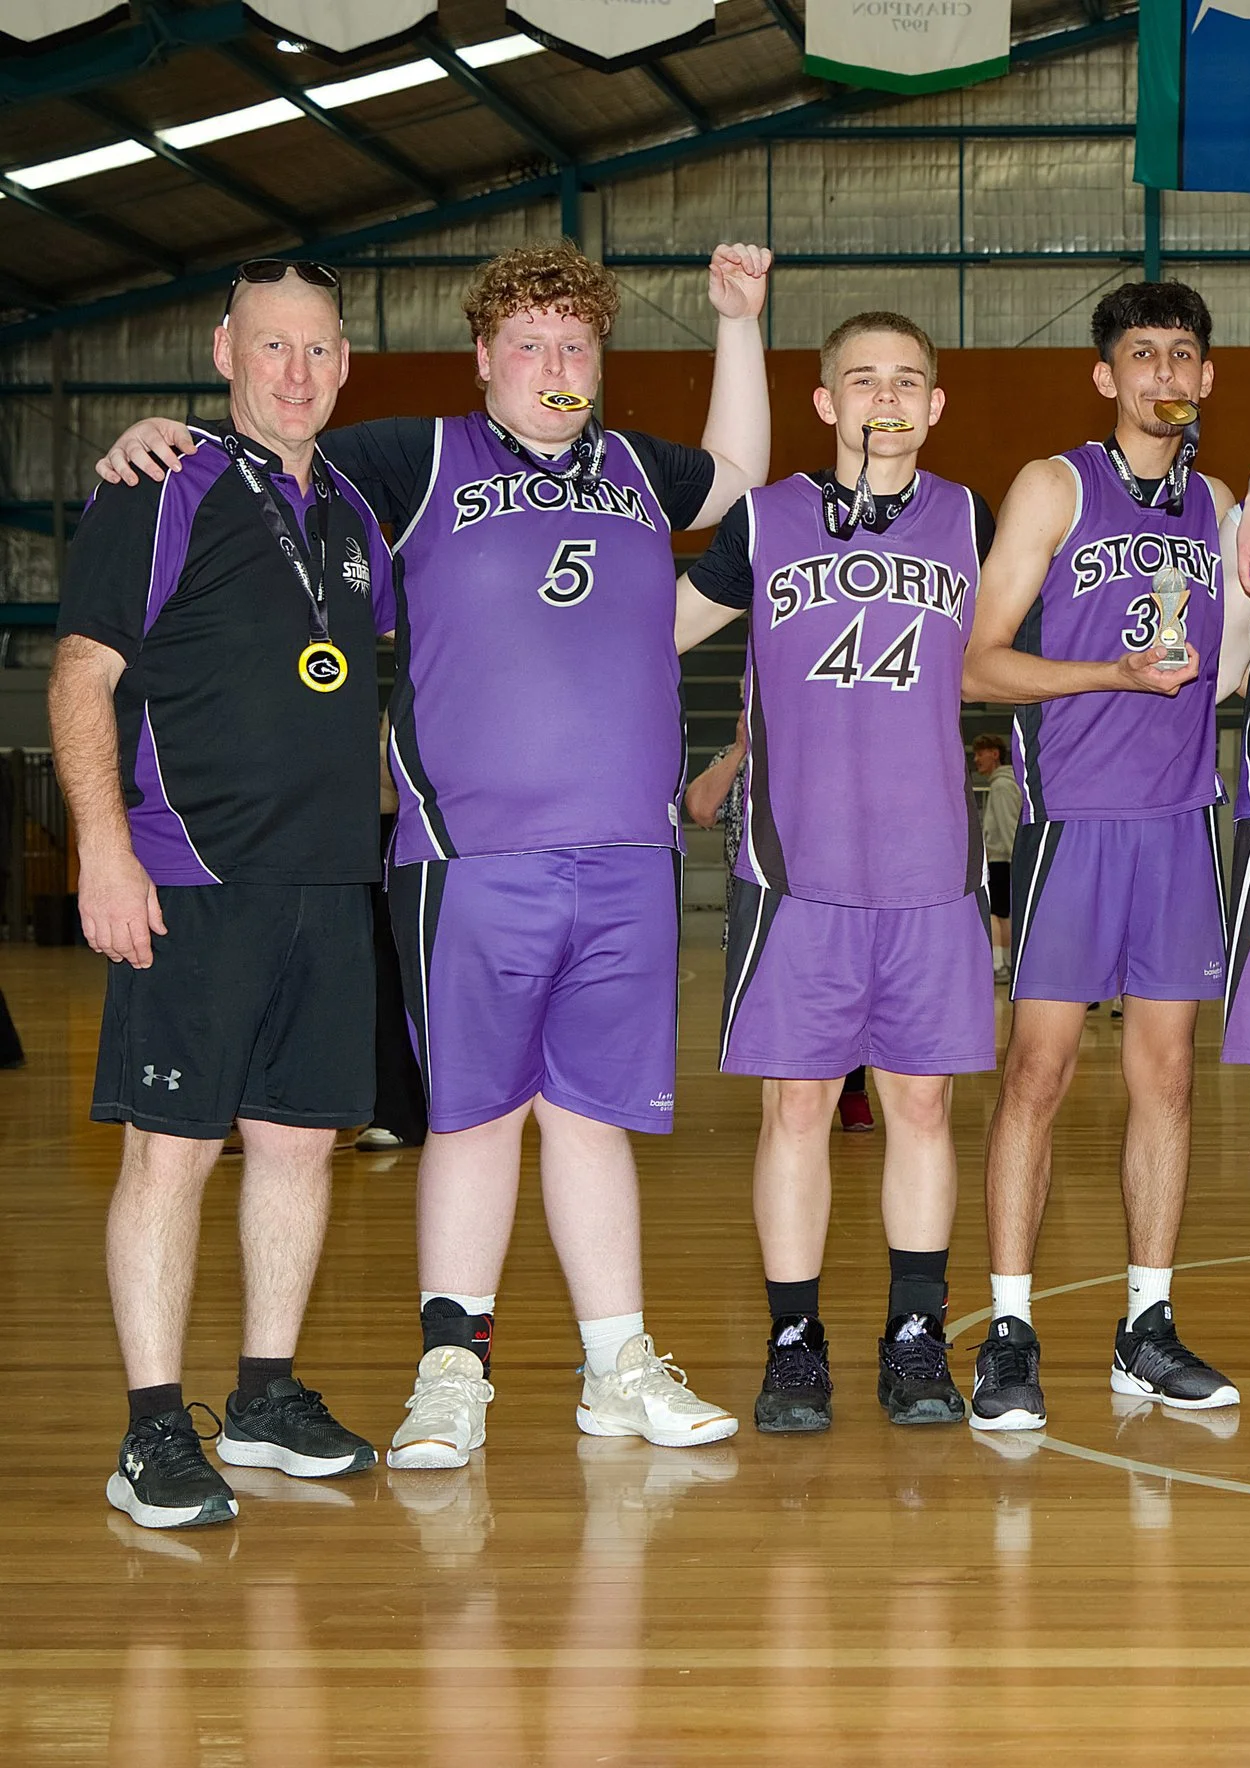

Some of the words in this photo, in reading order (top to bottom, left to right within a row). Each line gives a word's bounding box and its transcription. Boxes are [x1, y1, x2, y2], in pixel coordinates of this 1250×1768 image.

[235, 457, 262, 493] PACERS
[1110, 450, 1132, 481] PACERS
[452, 470, 657, 535] STORM
[826, 501, 837, 533] PACERS
[537, 539, 597, 608] 5
[767, 550, 971, 632] STORM
[804, 606, 926, 692] 44
